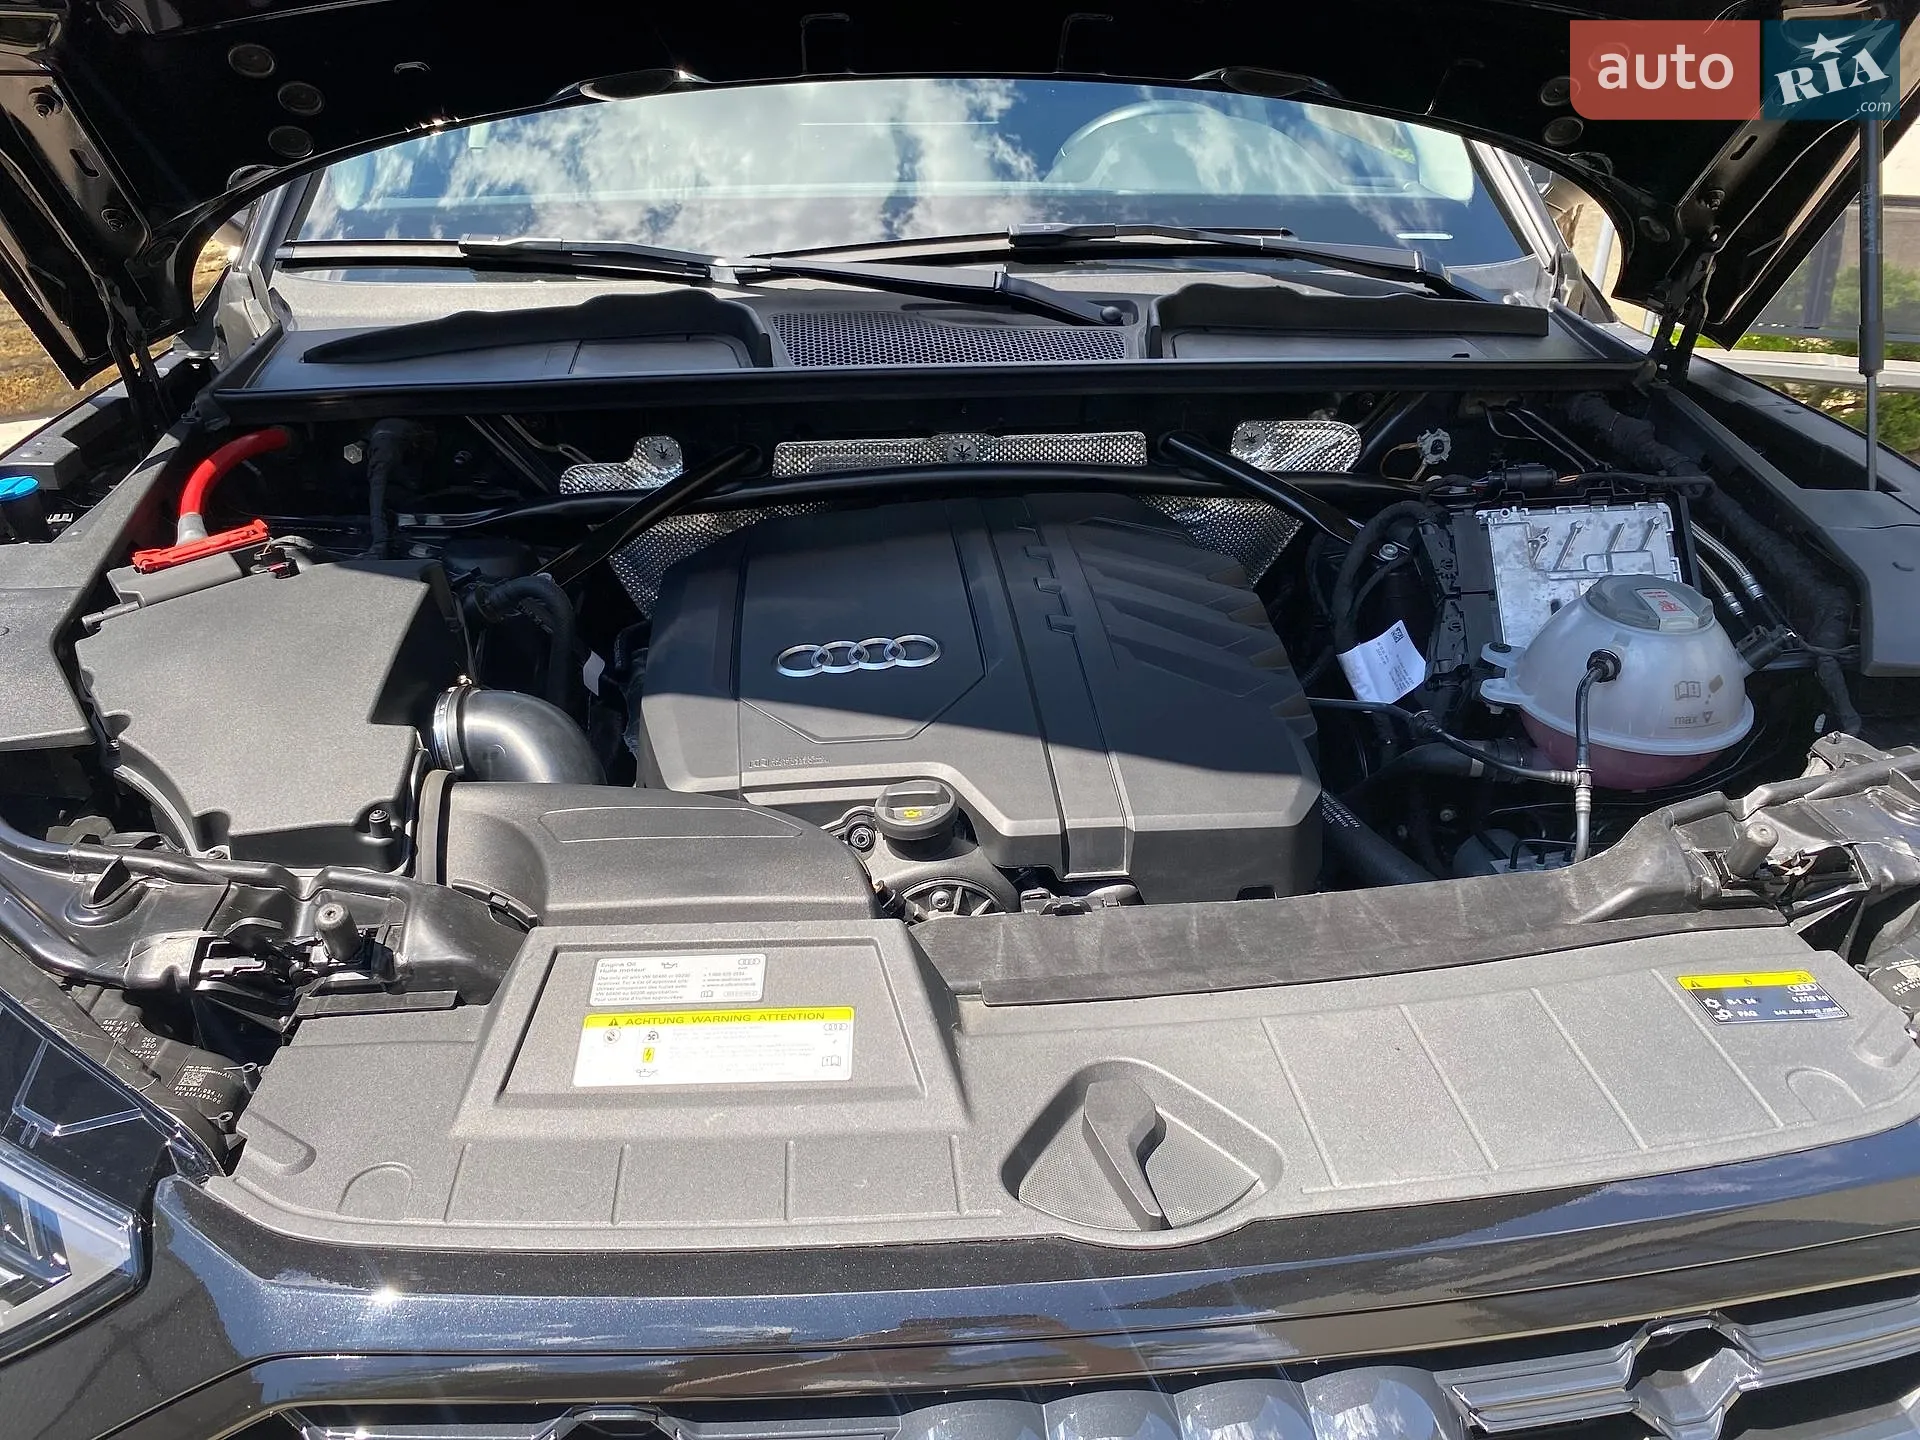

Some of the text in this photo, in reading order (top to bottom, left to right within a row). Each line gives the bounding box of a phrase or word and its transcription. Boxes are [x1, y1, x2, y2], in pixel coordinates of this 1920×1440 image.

[1674, 716, 1698, 725] max
[625, 1012, 825, 1025] ACHTUNG WARNING ATTENTION
